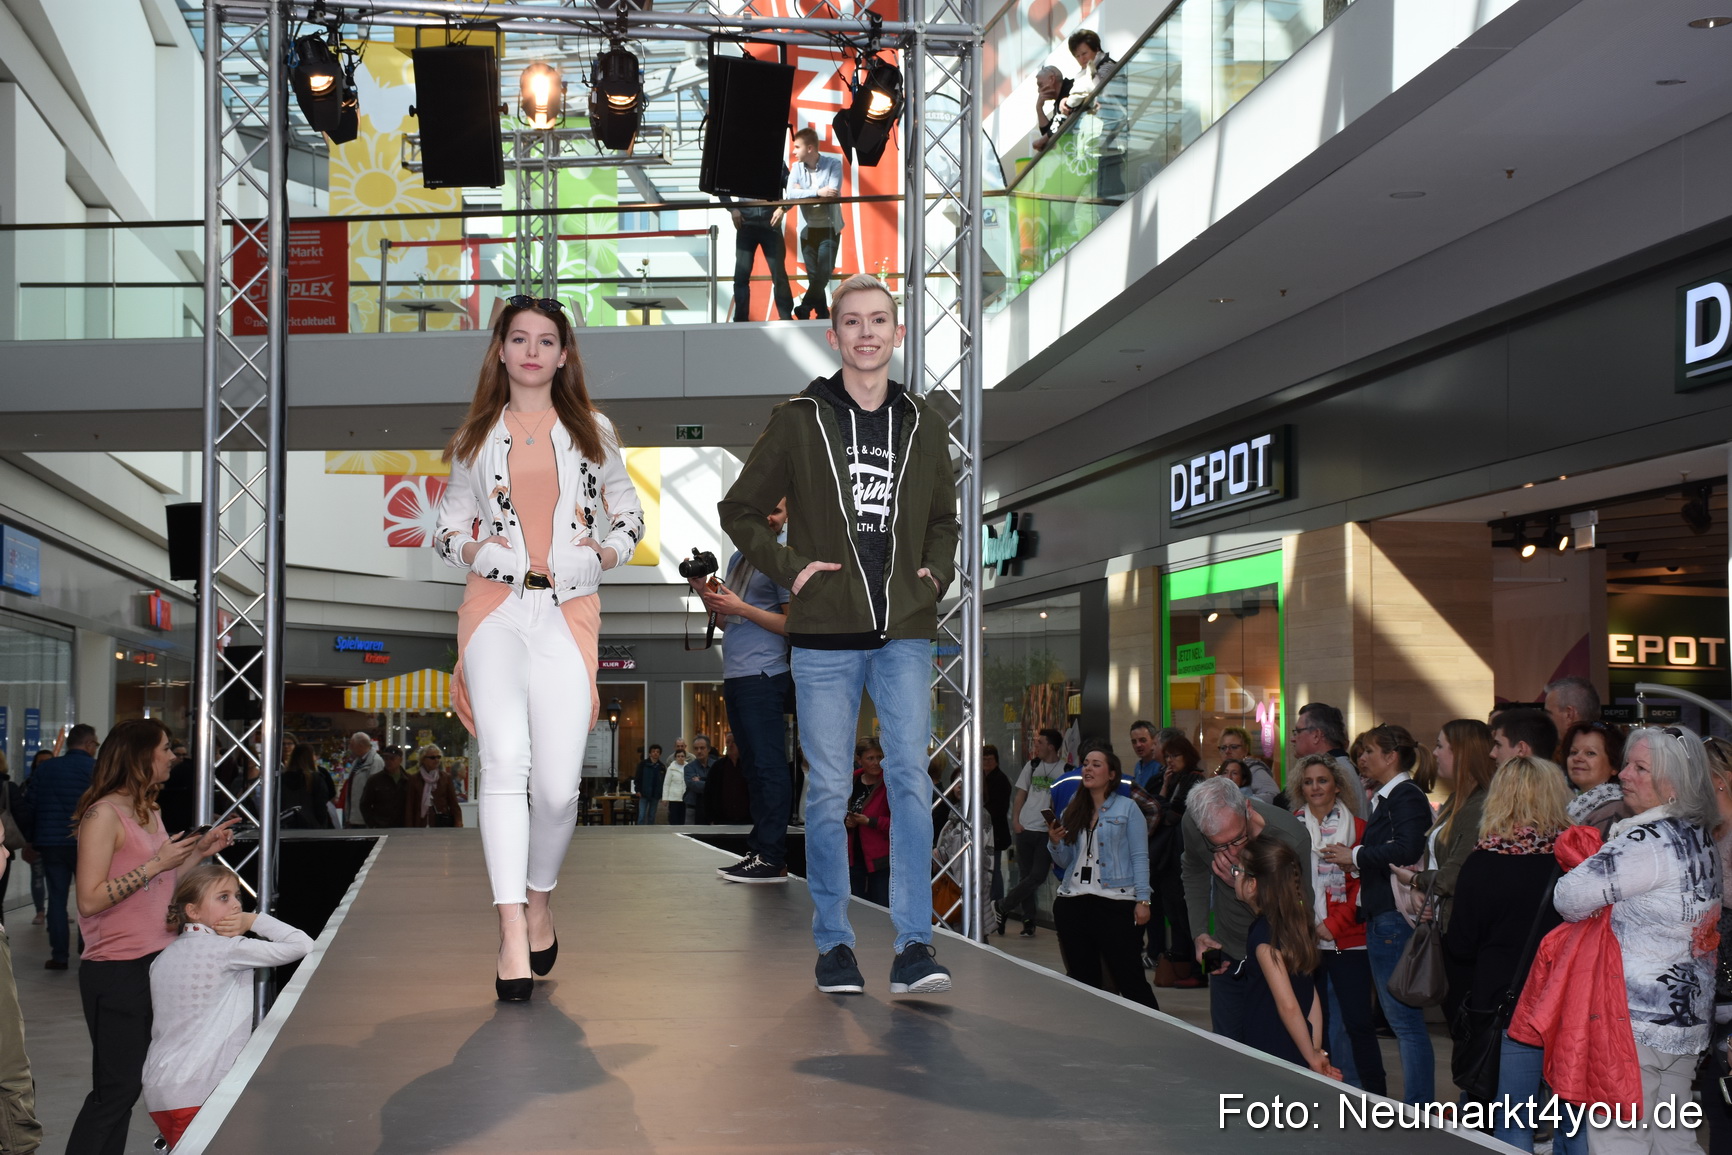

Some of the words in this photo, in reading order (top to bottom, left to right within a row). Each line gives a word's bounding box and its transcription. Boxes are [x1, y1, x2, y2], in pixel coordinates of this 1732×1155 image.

[257, 246, 324, 258] NMarkt
[246, 281, 334, 300] CIPLEX
[861, 445, 868, 454] &
[1171, 433, 1270, 512] DEPOT
[335, 636, 385, 652] Spielwaren
